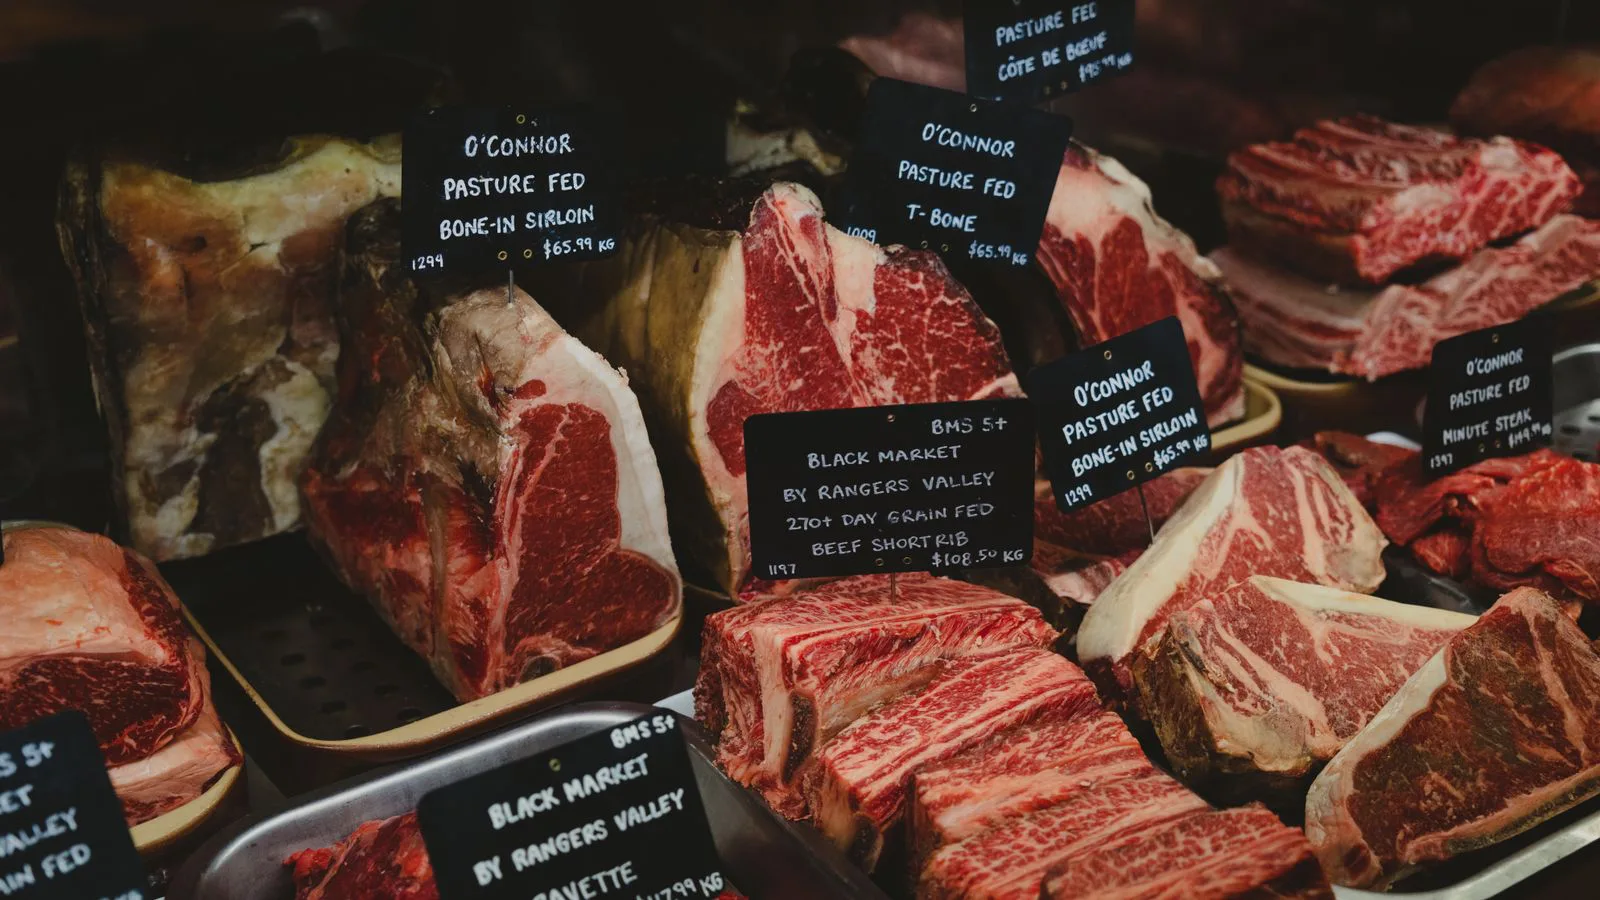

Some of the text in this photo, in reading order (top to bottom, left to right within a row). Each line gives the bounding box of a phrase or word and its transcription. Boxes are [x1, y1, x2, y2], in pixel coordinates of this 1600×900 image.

[995, 10, 1065, 46] PASTURE
[998, 56, 1036, 82] CÔTE
[1041, 47, 1062, 67] DE
[465, 133, 573, 157] O'CONNOR
[922, 122, 1015, 157] O'CONNOR
[443, 172, 586, 200] PASTURE FED
[898, 160, 1016, 199] PASTURE FED
[440, 204, 594, 240] BONE-IN SIRLOIN
[847, 226, 876, 245] 1009
[543, 237, 615, 260] $65.99 KG
[968, 240, 1027, 265] $65.99 KG
[1074, 360, 1155, 407] O'CONNOR
[1450, 374, 1531, 411] PASTURE FED
[931, 416, 1008, 435] BMS 5+
[1062, 386, 1174, 445] PASTURE FED
[1443, 408, 1532, 446] MINUTE STEAK
[807, 444, 962, 469] BLACK MARKET
[1071, 407, 1198, 478] BONE-IN SIRLOIN
[1153, 434, 1208, 470] $65.99 KG
[783, 471, 995, 502] BY RANGERS VALLEY
[1064, 483, 1093, 507] 1299
[786, 503, 995, 531] 270+ DAY GRAIN FED
[812, 539, 862, 556] BEEF
[931, 549, 1024, 568] $108.50 KG
[768, 563, 797, 576] 1197
[610, 714, 676, 749] BMS 5+
[0, 784, 34, 815] ET
[488, 753, 650, 830] BLACK MARKET
[473, 788, 685, 886] BY RANGERS VALLEY
[41, 843, 92, 880] FED
[699, 872, 723, 897] KG
